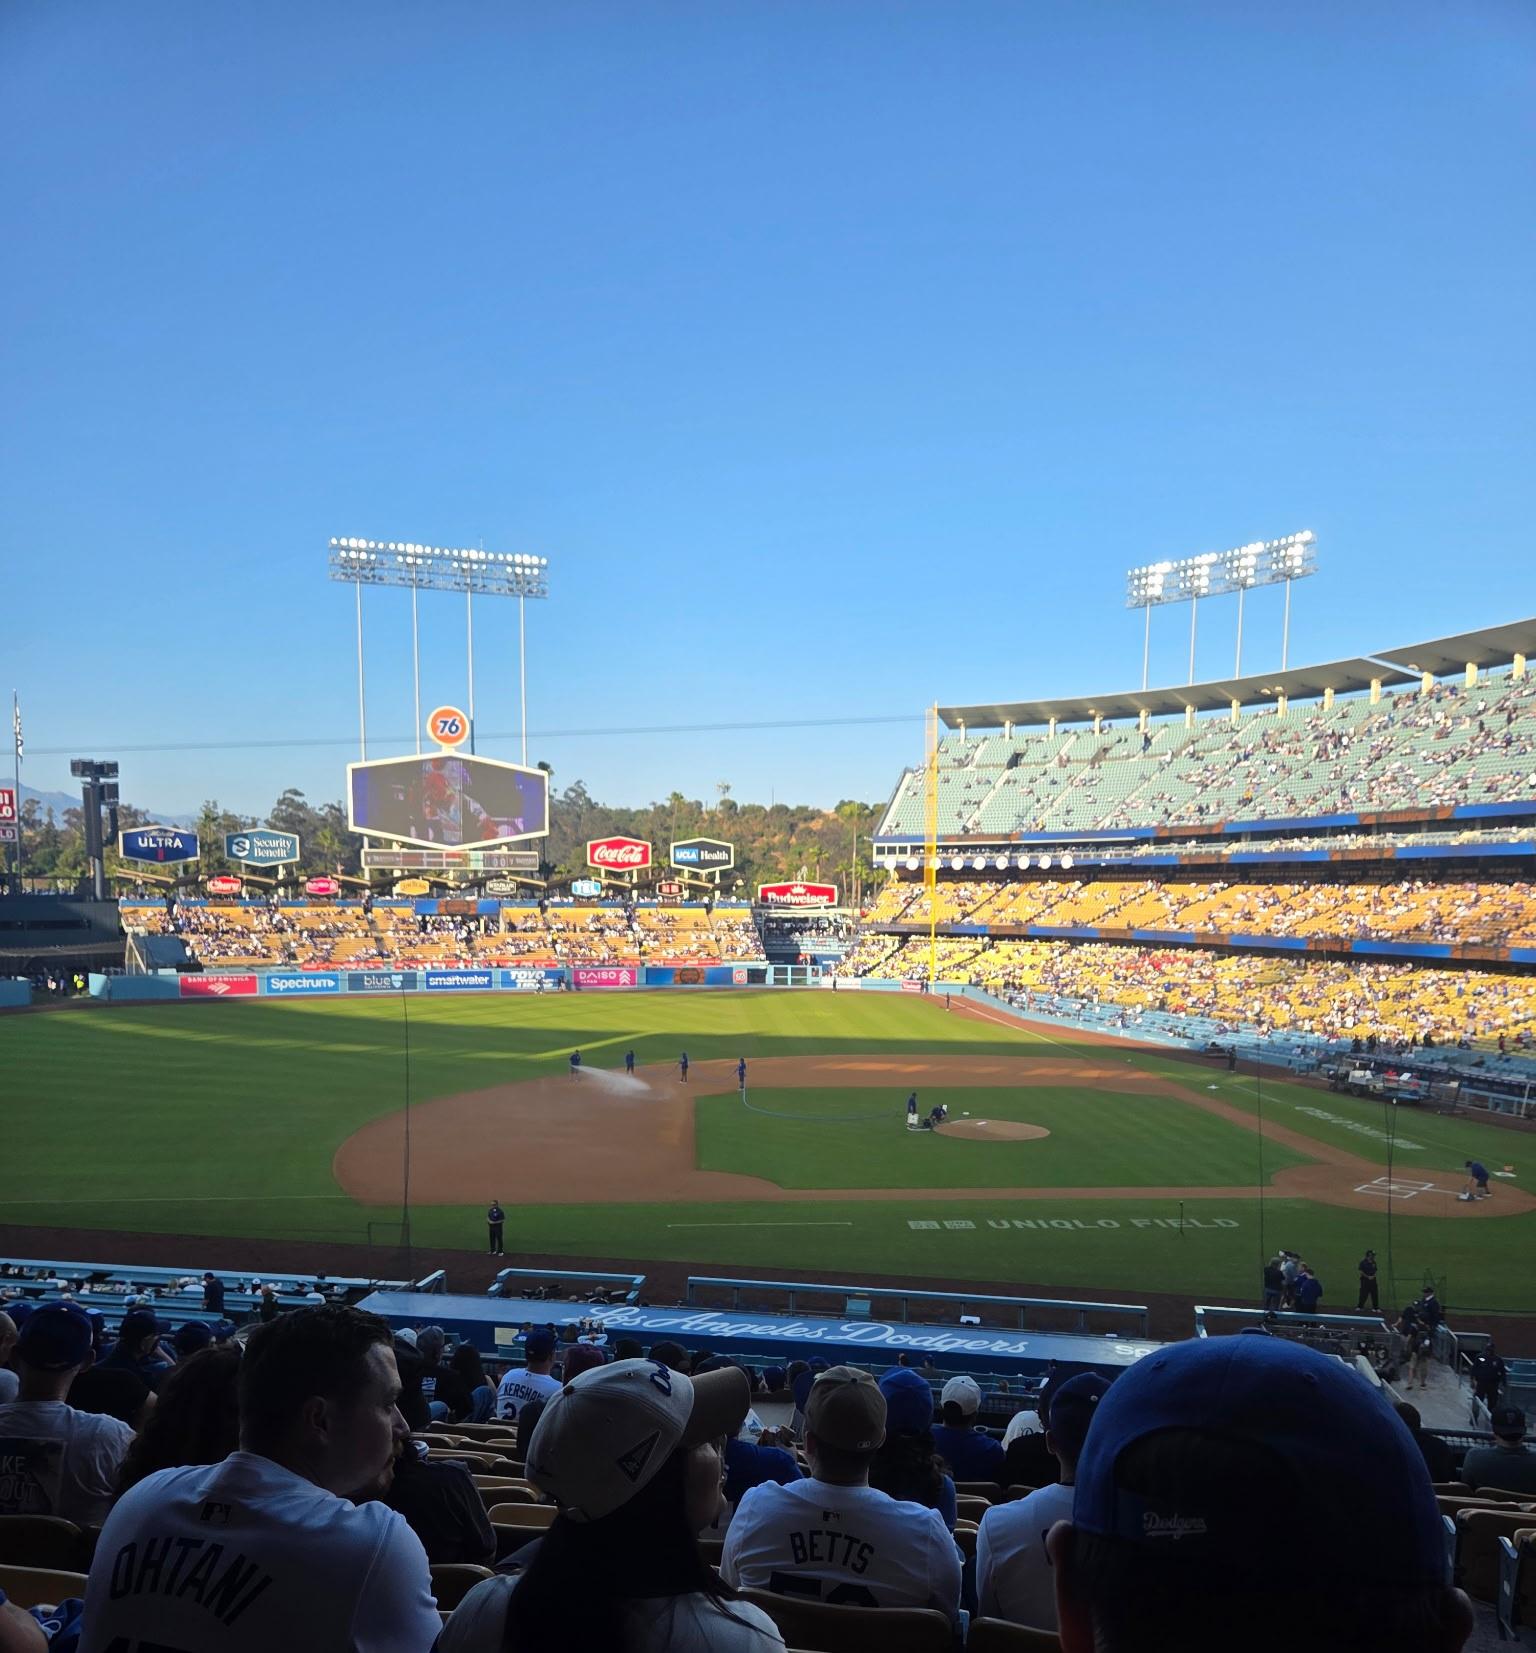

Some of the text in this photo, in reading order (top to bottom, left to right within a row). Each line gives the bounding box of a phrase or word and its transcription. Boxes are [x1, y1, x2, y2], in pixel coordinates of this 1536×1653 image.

[439, 718, 460, 735] 76
[138, 837, 183, 849] ULTRA
[253, 837, 292, 851] Security
[254, 847, 287, 858] Benefit
[675, 850, 729, 861] UCLA Health
[767, 892, 829, 904] Budweiser
[364, 975, 391, 986] blue
[429, 975, 491, 987] smartwater
[510, 970, 545, 980] TOYO
[579, 971, 617, 980] DAISO
[271, 977, 331, 991] Spectrum
[987, 1219, 1121, 1230] UNIQLO
[1128, 1218, 1240, 1229] FIELD
[561, 1306, 1029, 1353] Los Angeles Dodgers
[1143, 1511, 1208, 1539] Dodgers
[789, 1529, 875, 1575] BETTS
[109, 1535, 274, 1627] OHTANI
